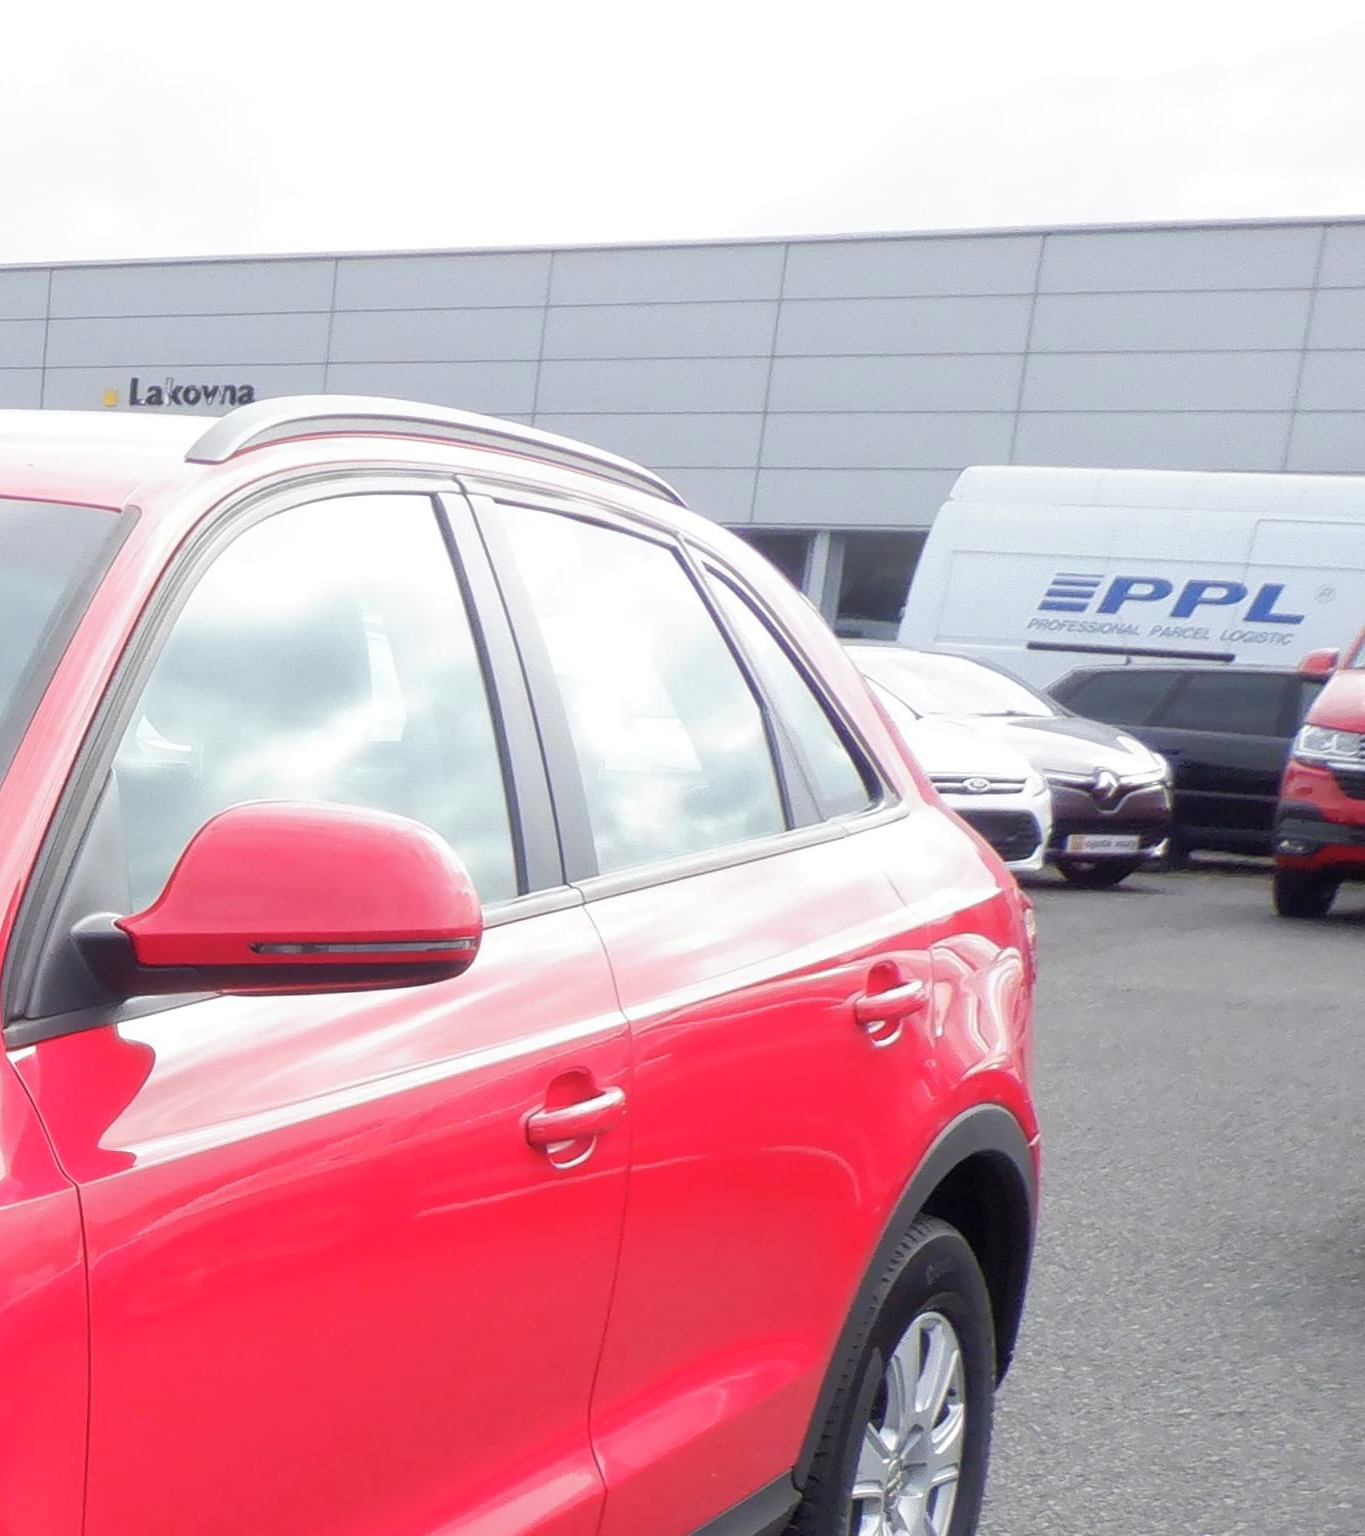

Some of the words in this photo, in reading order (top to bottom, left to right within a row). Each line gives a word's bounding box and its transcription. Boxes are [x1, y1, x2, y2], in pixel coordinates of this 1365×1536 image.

[1026, 616, 1140, 637] PROFESSIONAL
[1148, 624, 1210, 641] PARCEL
[1220, 629, 1296, 646] LOGISTIC
